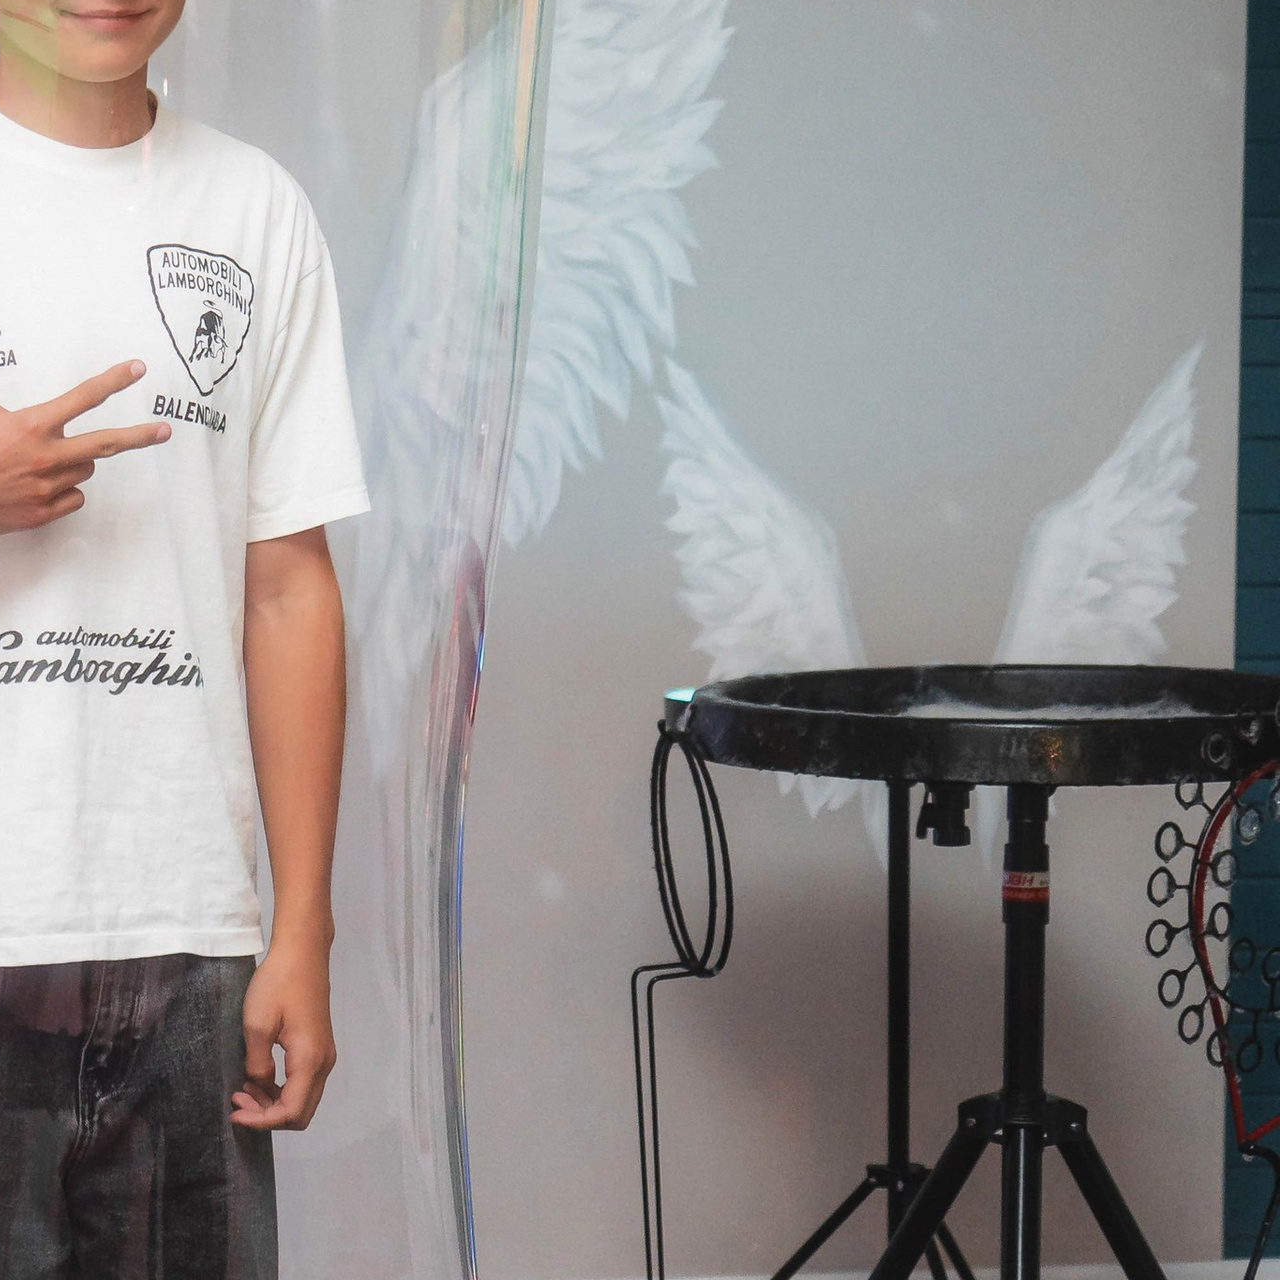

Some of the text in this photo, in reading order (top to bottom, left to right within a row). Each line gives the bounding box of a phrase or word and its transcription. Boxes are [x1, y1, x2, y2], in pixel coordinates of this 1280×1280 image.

[162, 252, 241, 291] AUTOMOBILI
[158, 272, 247, 315] LAMBORGHINI
[36, 625, 176, 650] automobili
